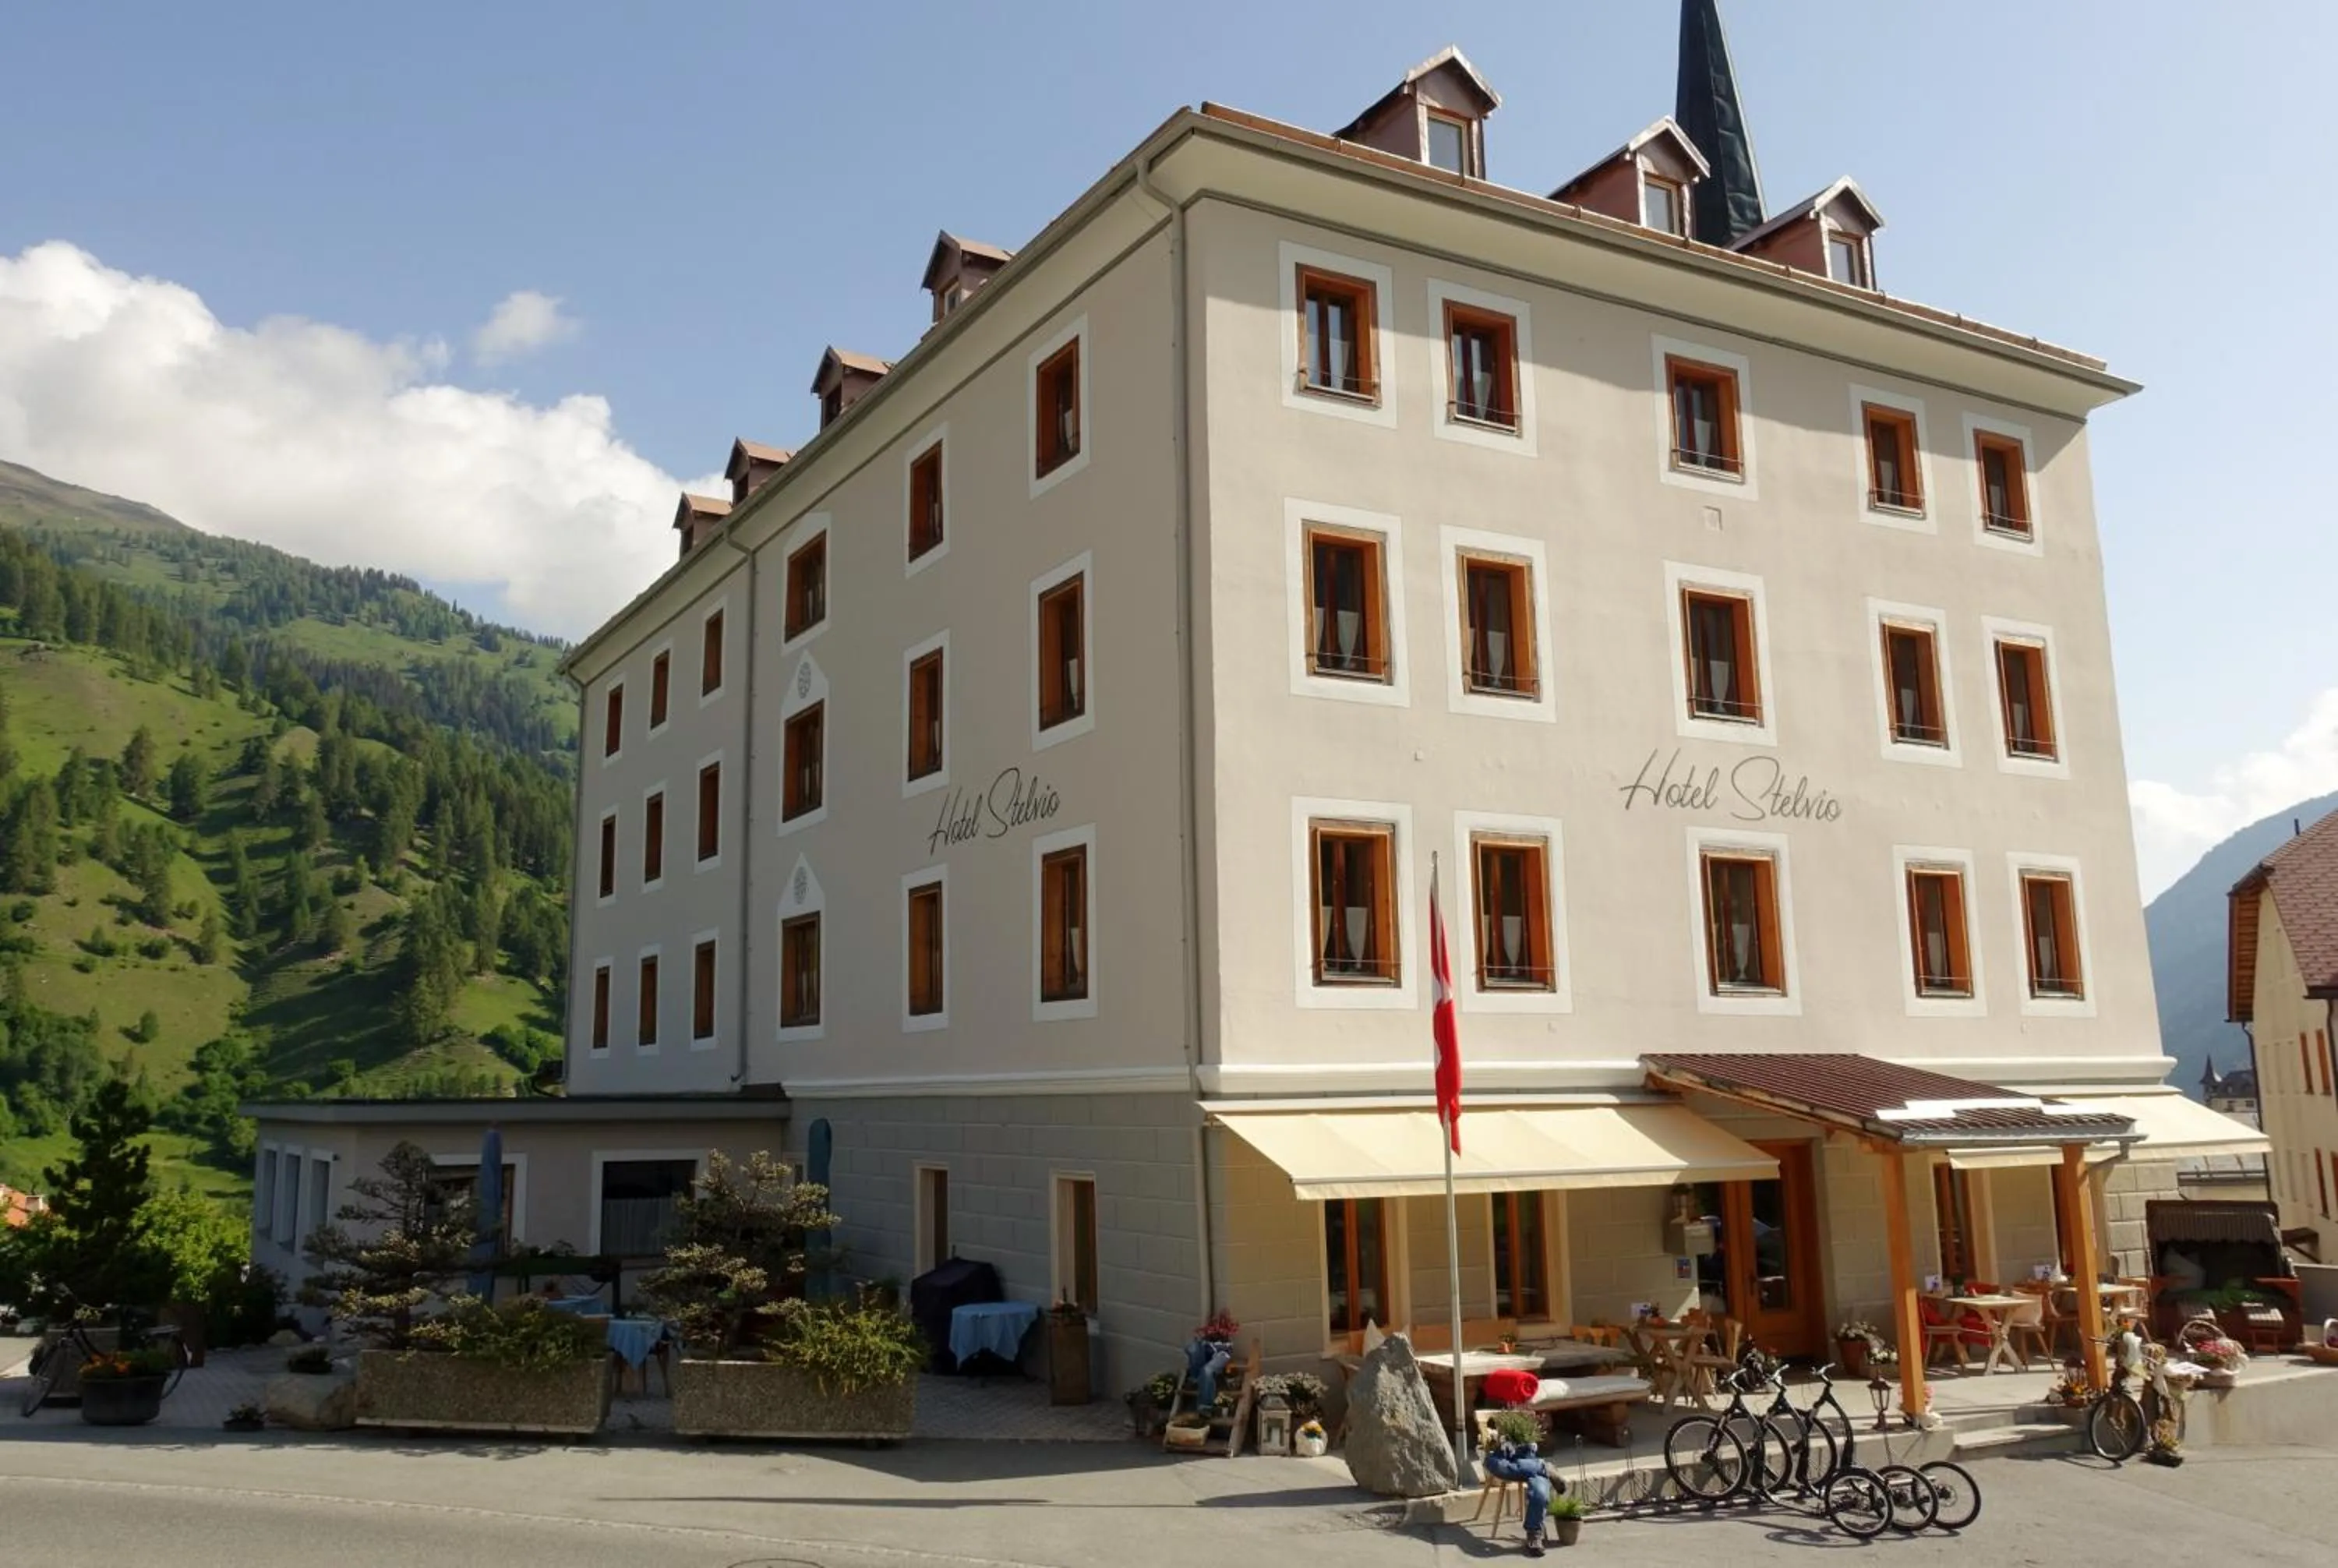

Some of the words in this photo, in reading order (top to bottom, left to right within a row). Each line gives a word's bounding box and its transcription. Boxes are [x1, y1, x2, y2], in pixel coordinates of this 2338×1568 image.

[927, 786, 983, 856] Hotel
[986, 767, 1061, 838] Stelvio
[1619, 747, 1719, 810] Hotel
[1730, 755, 1842, 821] Stelvio
